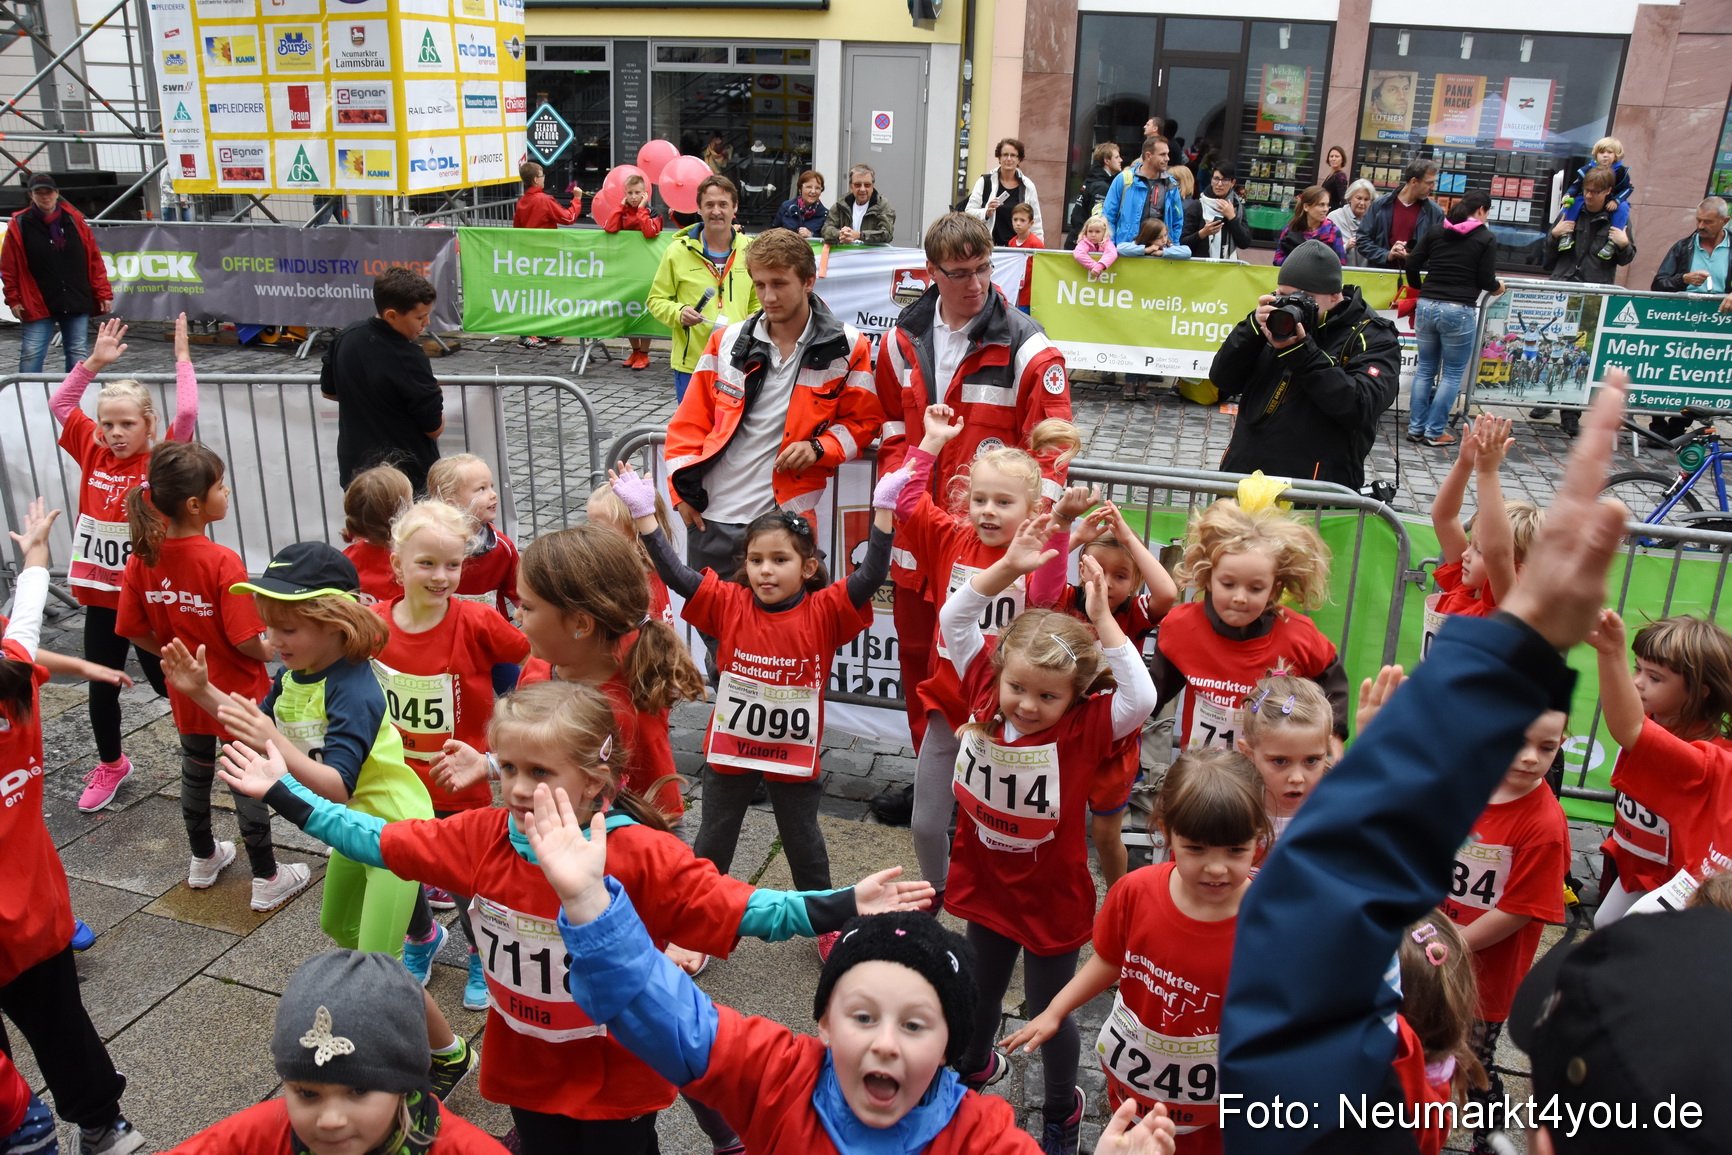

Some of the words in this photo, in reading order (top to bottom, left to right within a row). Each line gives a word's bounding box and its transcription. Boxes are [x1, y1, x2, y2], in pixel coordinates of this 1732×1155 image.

[335, 58, 385, 68] Lammsbräu
[1271, 67, 1300, 75] Welcher
[351, 89, 386, 99] Egner
[1445, 84, 1474, 97] PANIK
[218, 103, 264, 113] PFLEIDERER
[1443, 97, 1471, 108] MACHE
[290, 110, 309, 121] Braun
[1371, 113, 1404, 121] LUTHER
[534, 131, 559, 140] OPENING
[536, 123, 557, 132] SEASON
[232, 148, 263, 157] Egner
[478, 154, 503, 163] VARIOTEC
[439, 170, 459, 178] energie
[101, 254, 197, 279] BOCK
[222, 256, 275, 273] OFFICE
[279, 257, 359, 275] INDUSTRY
[493, 249, 604, 278] Herzlich
[1087, 271, 1117, 284] Der
[137, 284, 165, 293] smart
[167, 285, 205, 296] concepts
[1057, 280, 1133, 310] Neue
[1141, 296, 1187, 314] weiß,
[1191, 299, 1228, 315] wo's
[491, 288, 647, 318] Willkomme
[1606, 339, 1660, 357] Mehr
[1636, 362, 1664, 379] Ihr
[1669, 365, 1732, 384] Event!
[1628, 393, 1637, 403] &
[1640, 394, 1682, 406] Service
[80, 533, 133, 567] 7408
[180, 605, 214, 617] enegie
[733, 647, 797, 667] Neumarkter
[731, 661, 783, 682] Stadtlauf
[393, 675, 443, 690] BOCK
[728, 683, 759, 696] NeuerMarkt
[764, 687, 810, 700] BOCK
[381, 683, 444, 729] 045
[728, 696, 810, 741] 7099
[401, 734, 416, 748] da
[1200, 721, 1235, 751] 71
[737, 741, 788, 760] Victoria
[991, 746, 1050, 764] BOCK
[965, 746, 1049, 814] 7114
[976, 804, 1019, 834] Emma
[1121, 966, 1179, 1008] Stadtlauf
[510, 996, 551, 1025] Finia
[1145, 1032, 1217, 1054] BOCK
[1109, 1026, 1217, 1101] 7249
